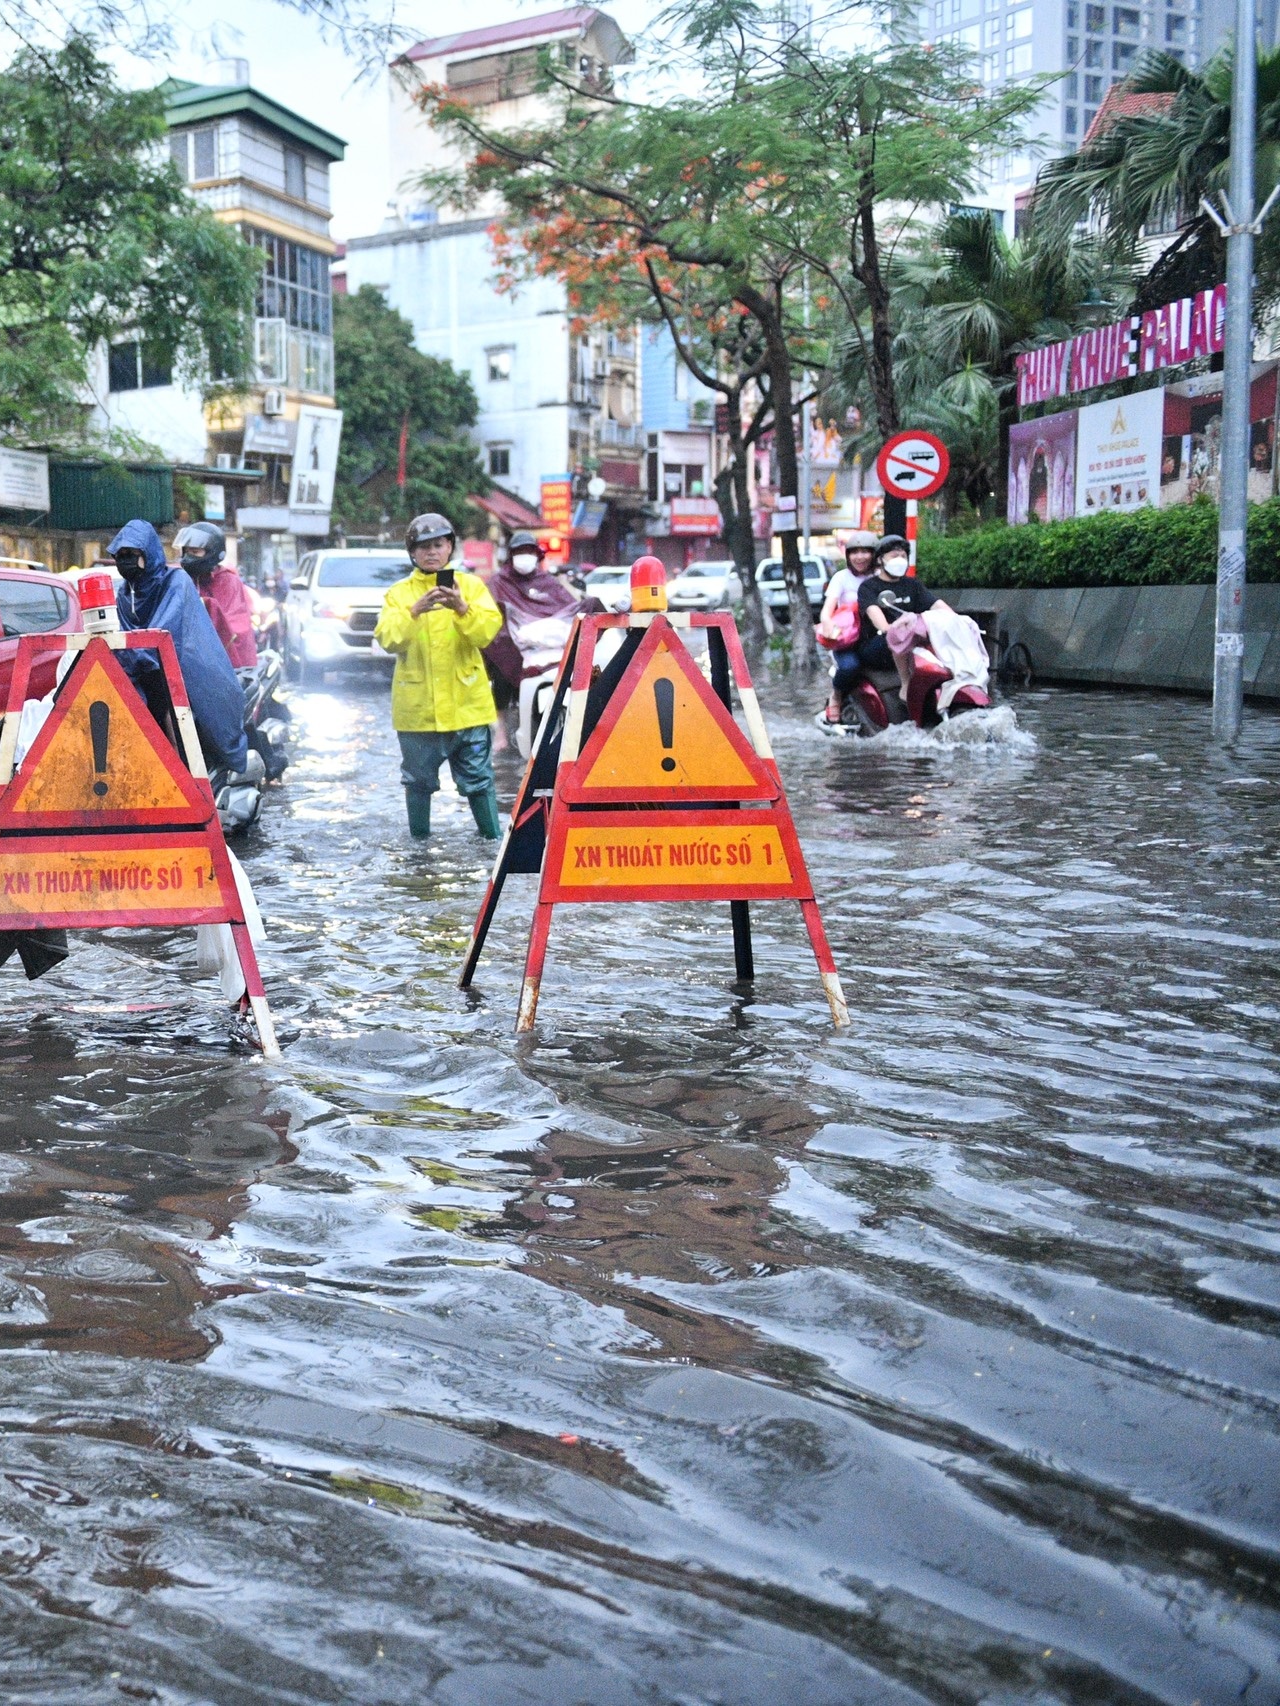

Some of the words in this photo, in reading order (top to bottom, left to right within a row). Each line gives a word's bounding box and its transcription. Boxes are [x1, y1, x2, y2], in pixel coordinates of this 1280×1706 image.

[1070, 317, 1139, 394] KHUE
[1140, 283, 1227, 372] PALAC
[574, 845, 601, 868] XN
[605, 838, 664, 868] THOÁT
[669, 836, 722, 867] NƯỚC
[726, 833, 752, 866] SỐ
[762, 843, 773, 866] 1
[3, 871, 30, 895] XN
[35, 864, 94, 894] THOÁT
[99, 861, 153, 892] NƯỚC
[157, 857, 183, 891] SỐ
[194, 865, 204, 889] 1
